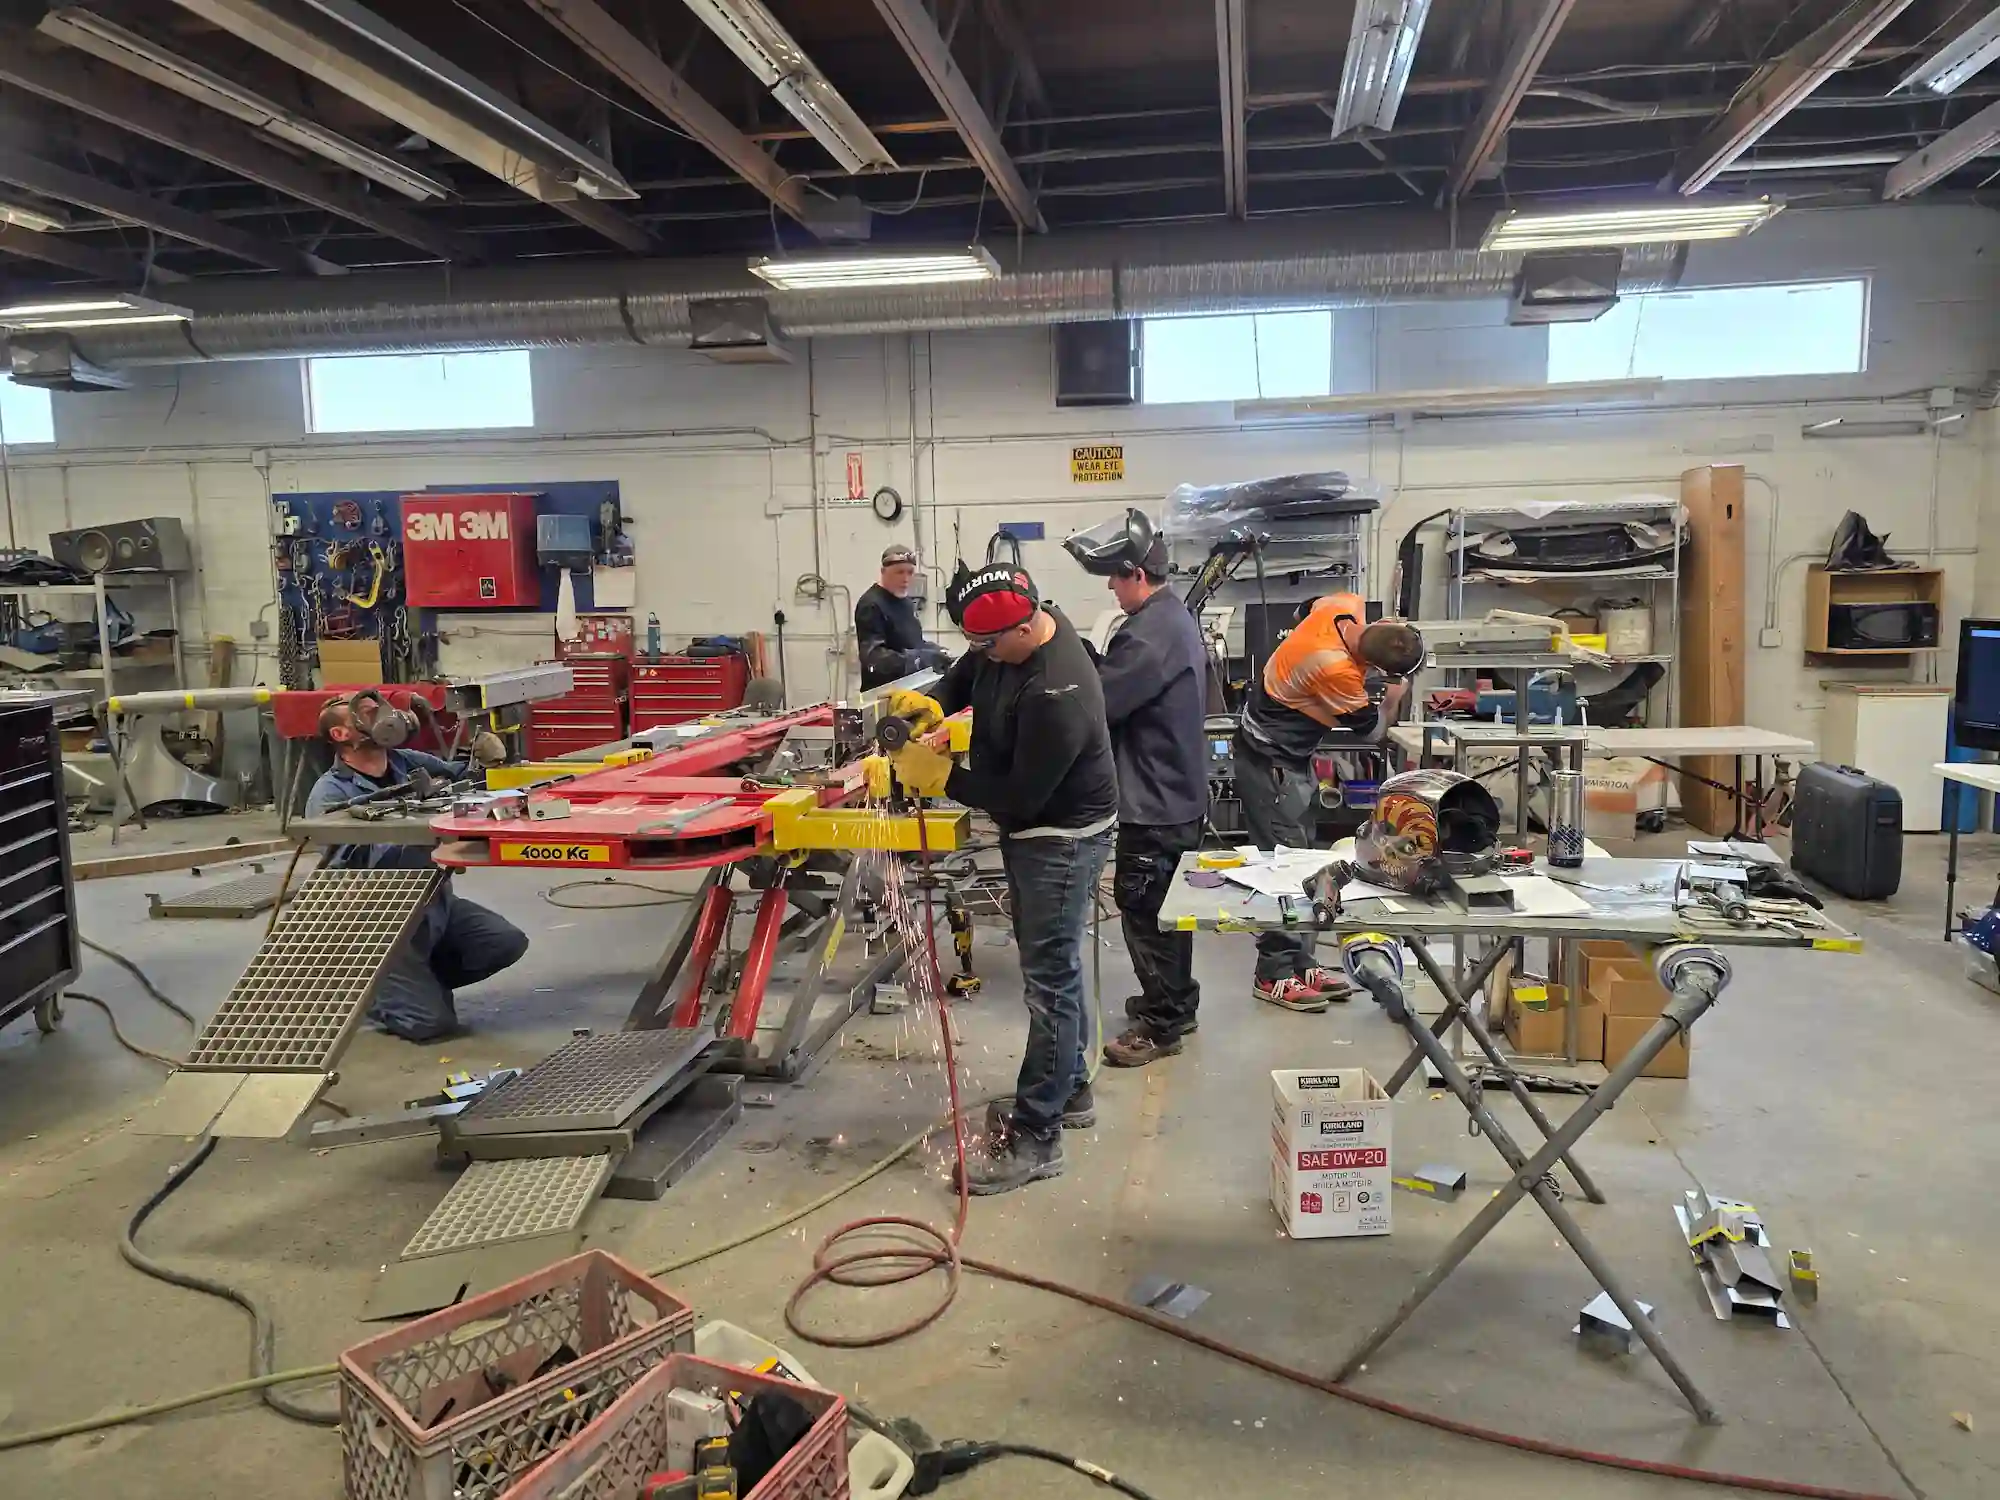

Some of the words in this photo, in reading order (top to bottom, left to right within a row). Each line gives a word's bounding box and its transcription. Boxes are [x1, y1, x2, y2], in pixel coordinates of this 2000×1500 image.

[1075, 447, 1121, 460] CAUTION
[1077, 461, 1101, 471] WEAR
[1104, 461, 1119, 470] EYE
[1073, 472, 1123, 482] PROTECTION
[406, 512, 456, 541] 3M
[459, 510, 509, 540] 3M
[519, 845, 563, 860] 4000
[1300, 1076, 1339, 1085] KIRKLAND
[1322, 1121, 1363, 1130] KIRKLAND
[1301, 1153, 1329, 1168] SAE
[1333, 1150, 1384, 1166] 0W-20
[1321, 1172, 1348, 1180] MOTOR
[1351, 1171, 1363, 1179] OIL
[1337, 1197, 1346, 1208] 2
